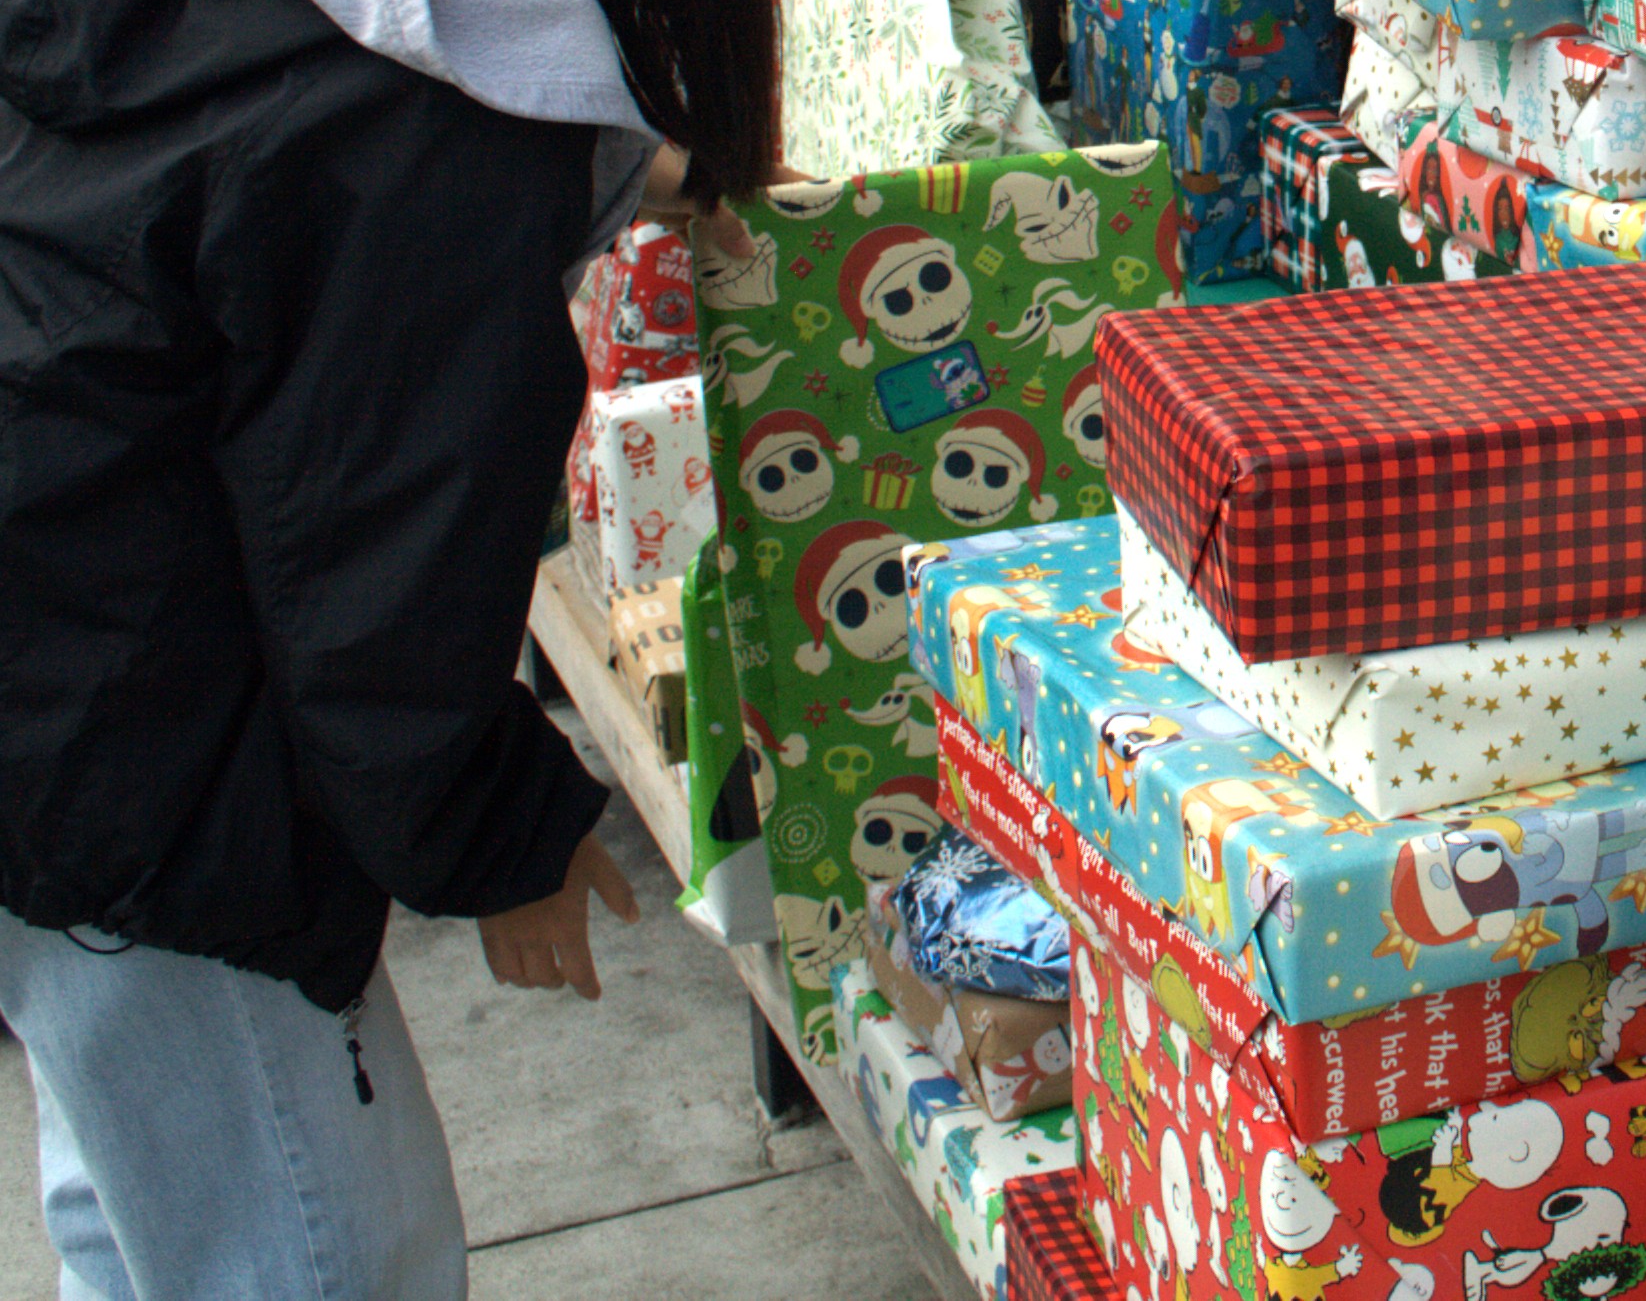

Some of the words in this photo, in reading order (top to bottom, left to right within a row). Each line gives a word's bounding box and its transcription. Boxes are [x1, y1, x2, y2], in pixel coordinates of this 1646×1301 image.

[976, 740, 996, 771] that
[1007, 770, 1038, 817] shoes
[961, 770, 981, 812] that
[981, 792, 997, 822] the
[997, 809, 1024, 850] most
[1126, 921, 1150, 964] But
[1197, 982, 1223, 1031] that
[1380, 1032, 1407, 1070] his
[1424, 1029, 1459, 1089] that
[1483, 1011, 1511, 1064] that
[1319, 1029, 1350, 1135] screwed
[1374, 1069, 1408, 1124] hea
